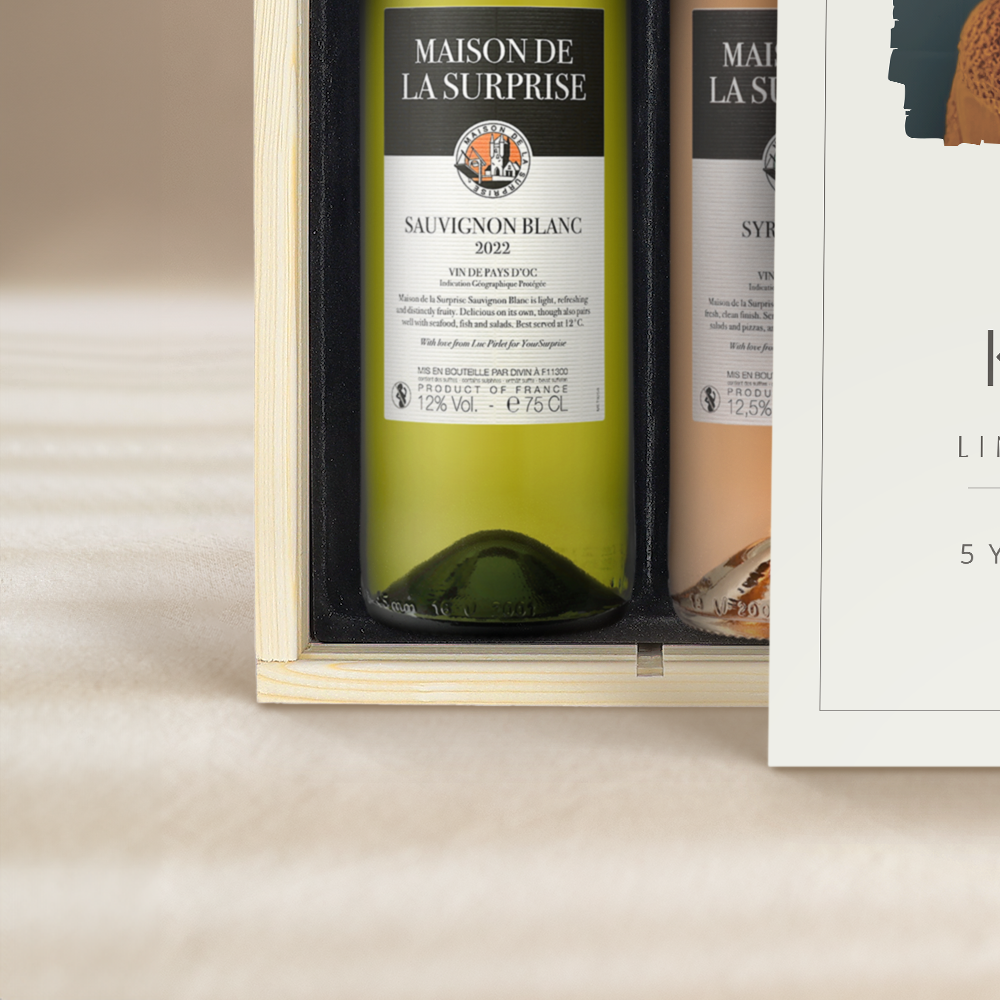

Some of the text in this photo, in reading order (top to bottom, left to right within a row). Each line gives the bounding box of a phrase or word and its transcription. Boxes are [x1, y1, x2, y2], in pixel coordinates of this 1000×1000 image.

[415, 38, 574, 64] MAISON DE
[722, 42, 777, 67] MAI
[401, 72, 587, 101] LA SURPRISE
[709, 76, 746, 103] LA
[464, 125, 528, 196] MAISON DE LA SURPRISE
[405, 216, 582, 234] SAUVIGNON BLANC
[742, 220, 775, 238] SYR
[475, 241, 510, 255] 2022
[449, 267, 538, 277] VIN DE PAYS D'OC
[472, 280, 517, 289] Géographique
[518, 280, 546, 289] Protégée
[420, 294, 428, 303] de
[430, 294, 435, 303] la
[437, 295, 466, 306] Surprise
[468, 296, 507, 306] Sauvignon
[509, 296, 529, 304] Blanc
[531, 296, 537, 304] is
[558, 295, 588, 306] refreshing
[731, 299, 739, 307] de
[741, 299, 746, 307] la
[407, 306, 435, 317] distinctly
[460, 307, 495, 316] Delicious
[508, 308, 517, 316] its
[538, 308, 562, 318] though
[563, 308, 575, 316] also
[576, 307, 591, 317] pairs
[722, 310, 739, 319] clean
[401, 318, 413, 326] well
[414, 319, 428, 327] with
[459, 320, 473, 328] fish
[474, 320, 488, 328] and
[516, 320, 531, 328] Best
[533, 320, 556, 328] served
[557, 320, 563, 328] at
[729, 322, 740, 331] and
[420, 338, 567, 350] With love from Luc Pirlet for YourSurprise
[730, 342, 745, 350] With
[747, 343, 761, 351] love
[417, 367, 431, 375] MIS
[432, 367, 443, 375] EN
[445, 368, 489, 376] BOUTEILLE
[492, 368, 508, 376] PAR
[727, 370, 740, 378] MIS
[742, 371, 753, 379] EN
[418, 384, 568, 394] PRODUCT OF FRANCE
[727, 388, 772, 398] PRODU
[418, 395, 447, 412] 12%
[451, 395, 478, 413] Vol.
[525, 396, 544, 413] 75
[548, 396, 568, 412] CL
[728, 399, 772, 418] 12,5%
[960, 543, 975, 565] 5
